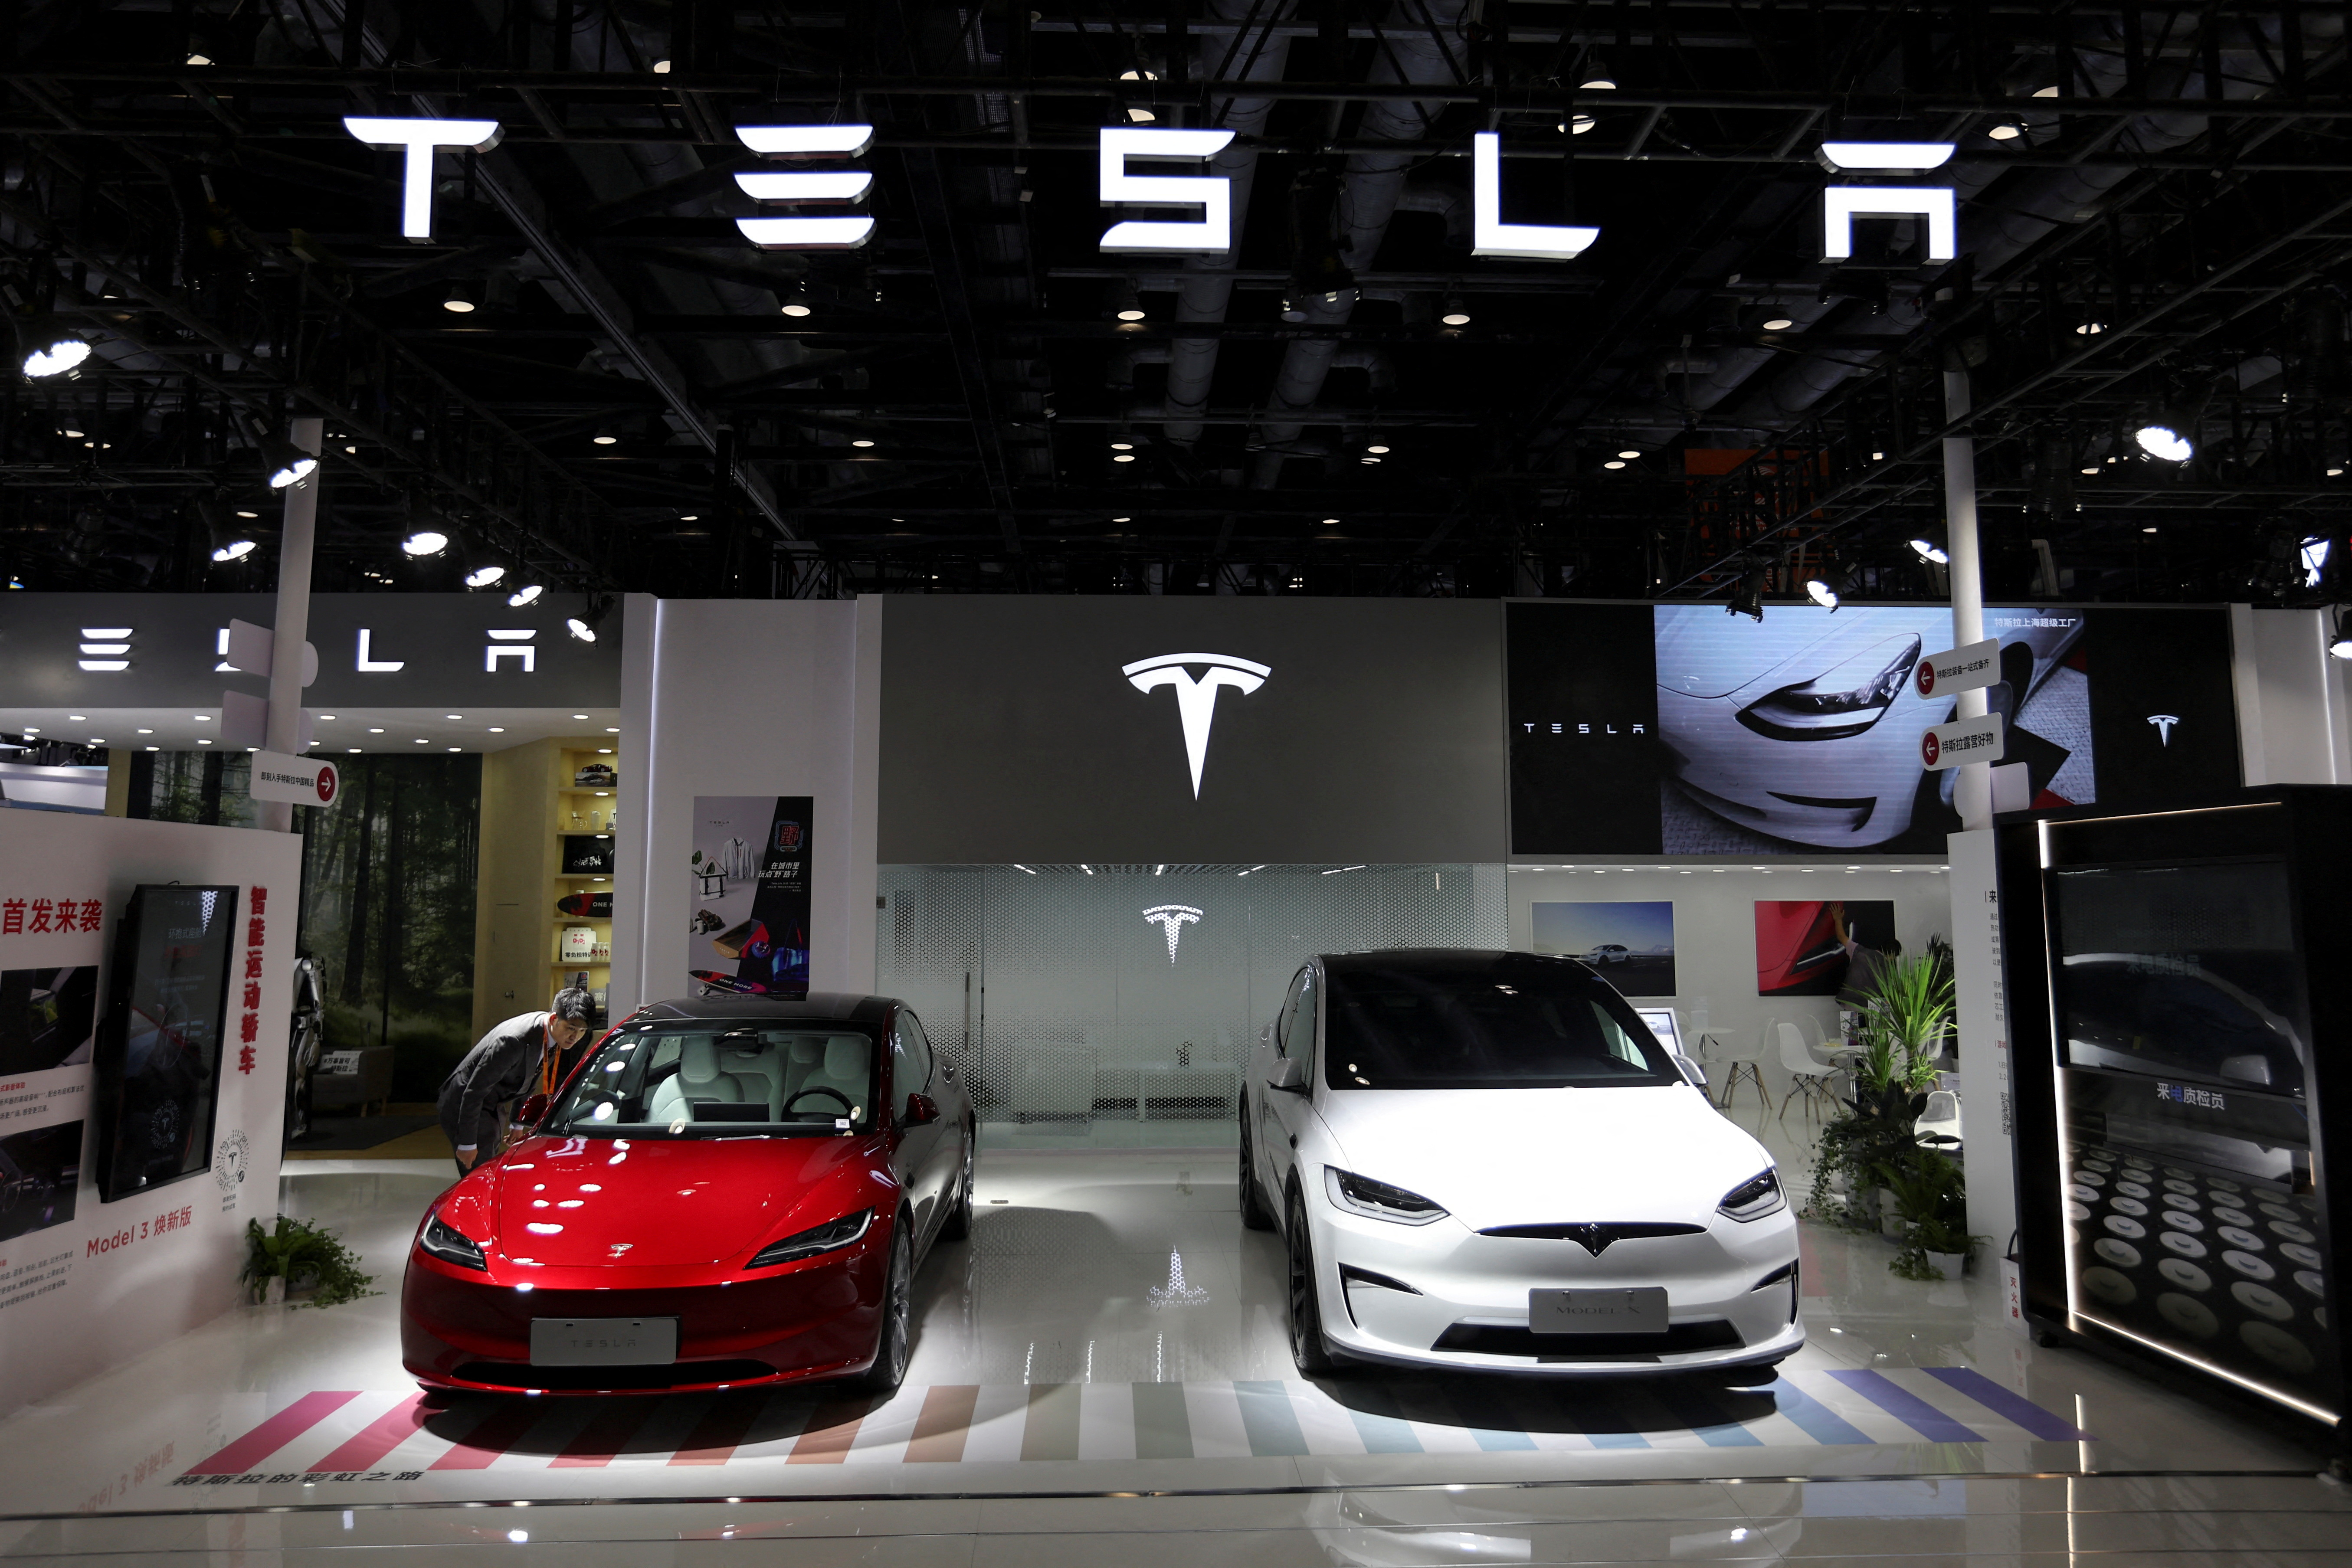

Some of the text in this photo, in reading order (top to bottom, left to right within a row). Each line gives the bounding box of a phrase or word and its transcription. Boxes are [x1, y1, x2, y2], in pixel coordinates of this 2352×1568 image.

[343, 116, 1957, 261] TESLA
[1994, 618, 2076, 628] 特斯拉上海超级工厂
[1937, 658, 1989, 680] 特斯拉装备一站式备齐
[1523, 723, 1644, 734] TESLA
[1941, 731, 1994, 753] 特斯拉露营好物
[261, 771, 314, 787] 即刻入手特斯拉中国精品
[780, 825, 799, 845] 野
[2, 897, 103, 934] 首发来袭
[238, 885, 268, 1074] 智能运动轿车
[734, 982, 753, 990] MORE
[87, 1205, 193, 1258] Model 3 焕新版
[2010, 1277, 2018, 1319] 灭火器
[1556, 1306, 1641, 1315] MODEL X
[571, 1339, 636, 1348] TESLA
[171, 1470, 425, 1486] 特斯拉的彩虹之路
